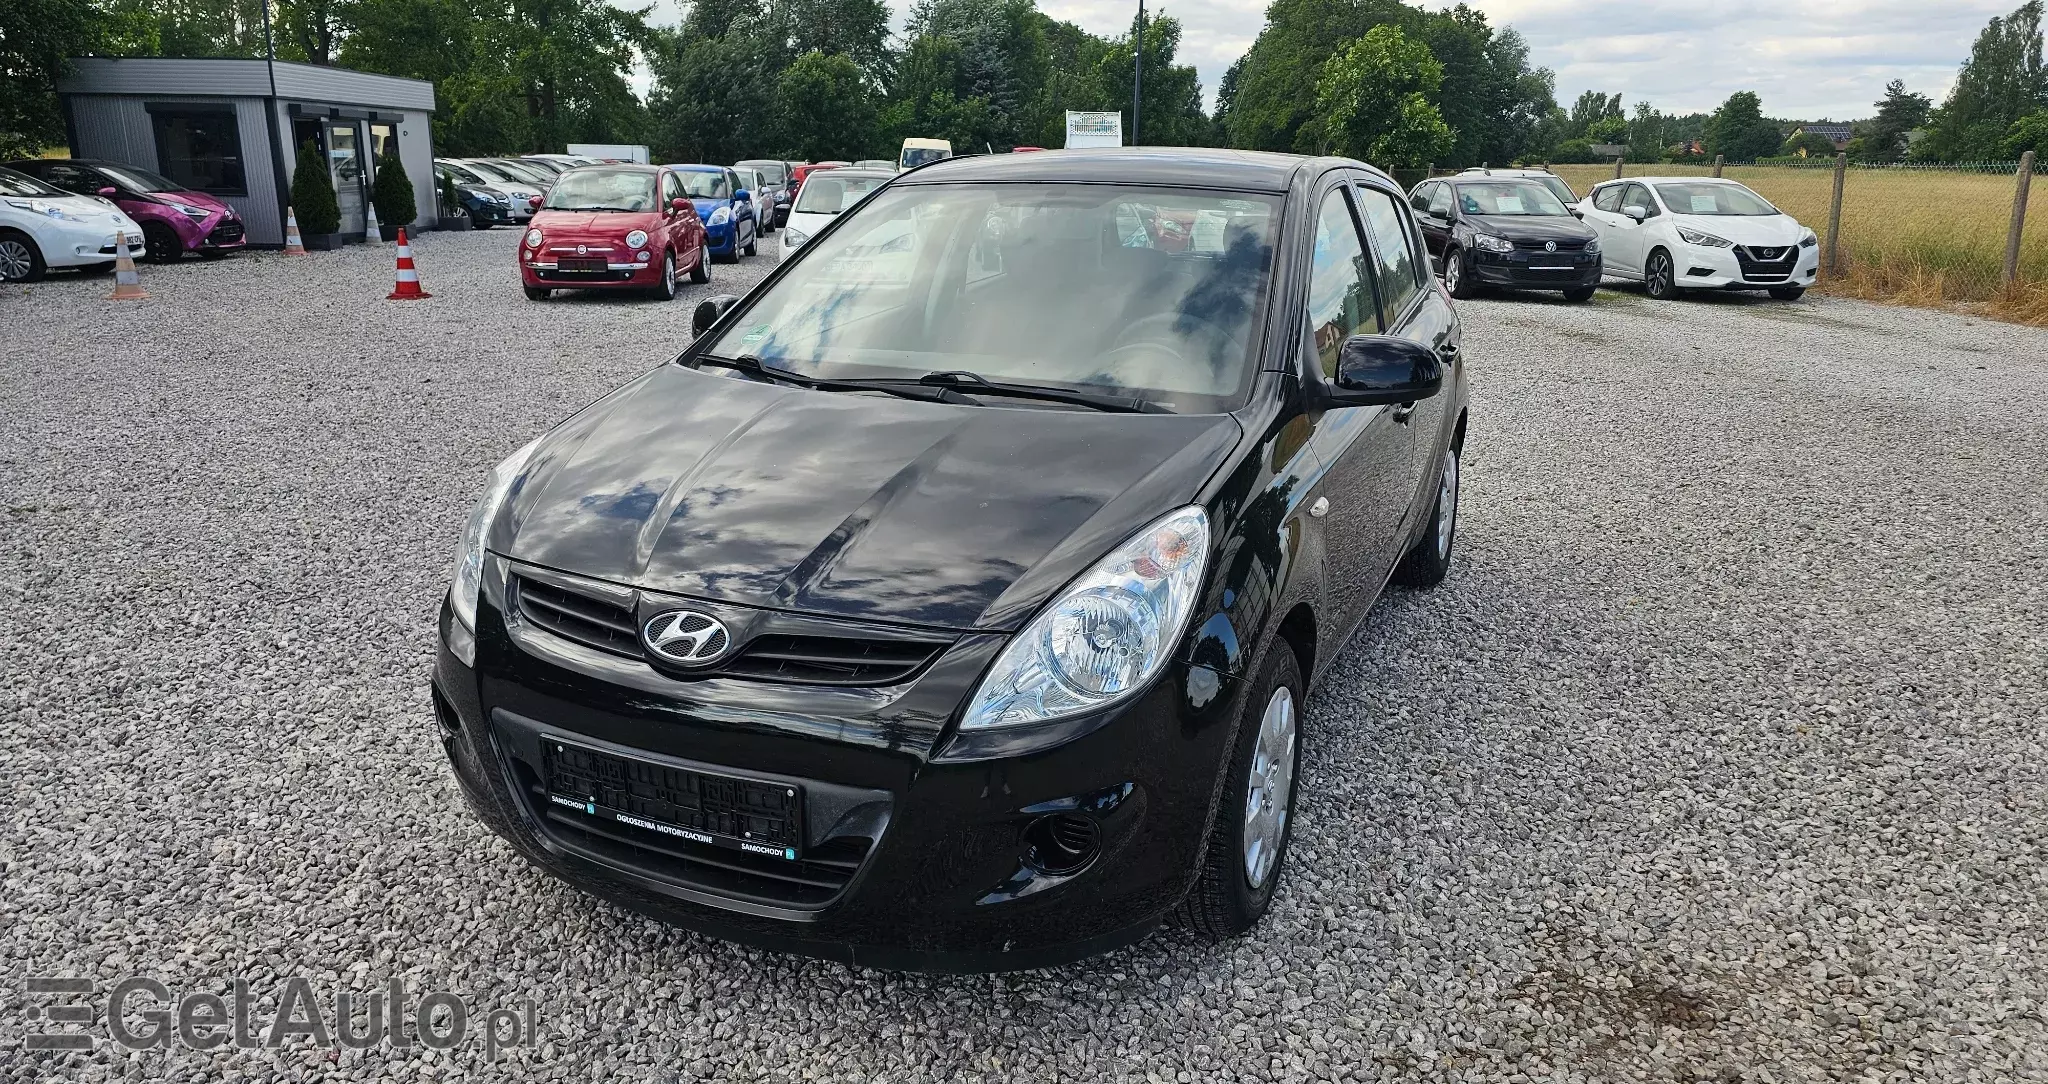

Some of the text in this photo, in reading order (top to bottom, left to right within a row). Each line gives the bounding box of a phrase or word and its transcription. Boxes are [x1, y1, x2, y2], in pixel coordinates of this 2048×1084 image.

[551, 795, 585, 810] SAMOCHODY
[657, 824, 713, 844] MOTORYZACYJNE
[741, 843, 783, 857] SAMOCHODY
